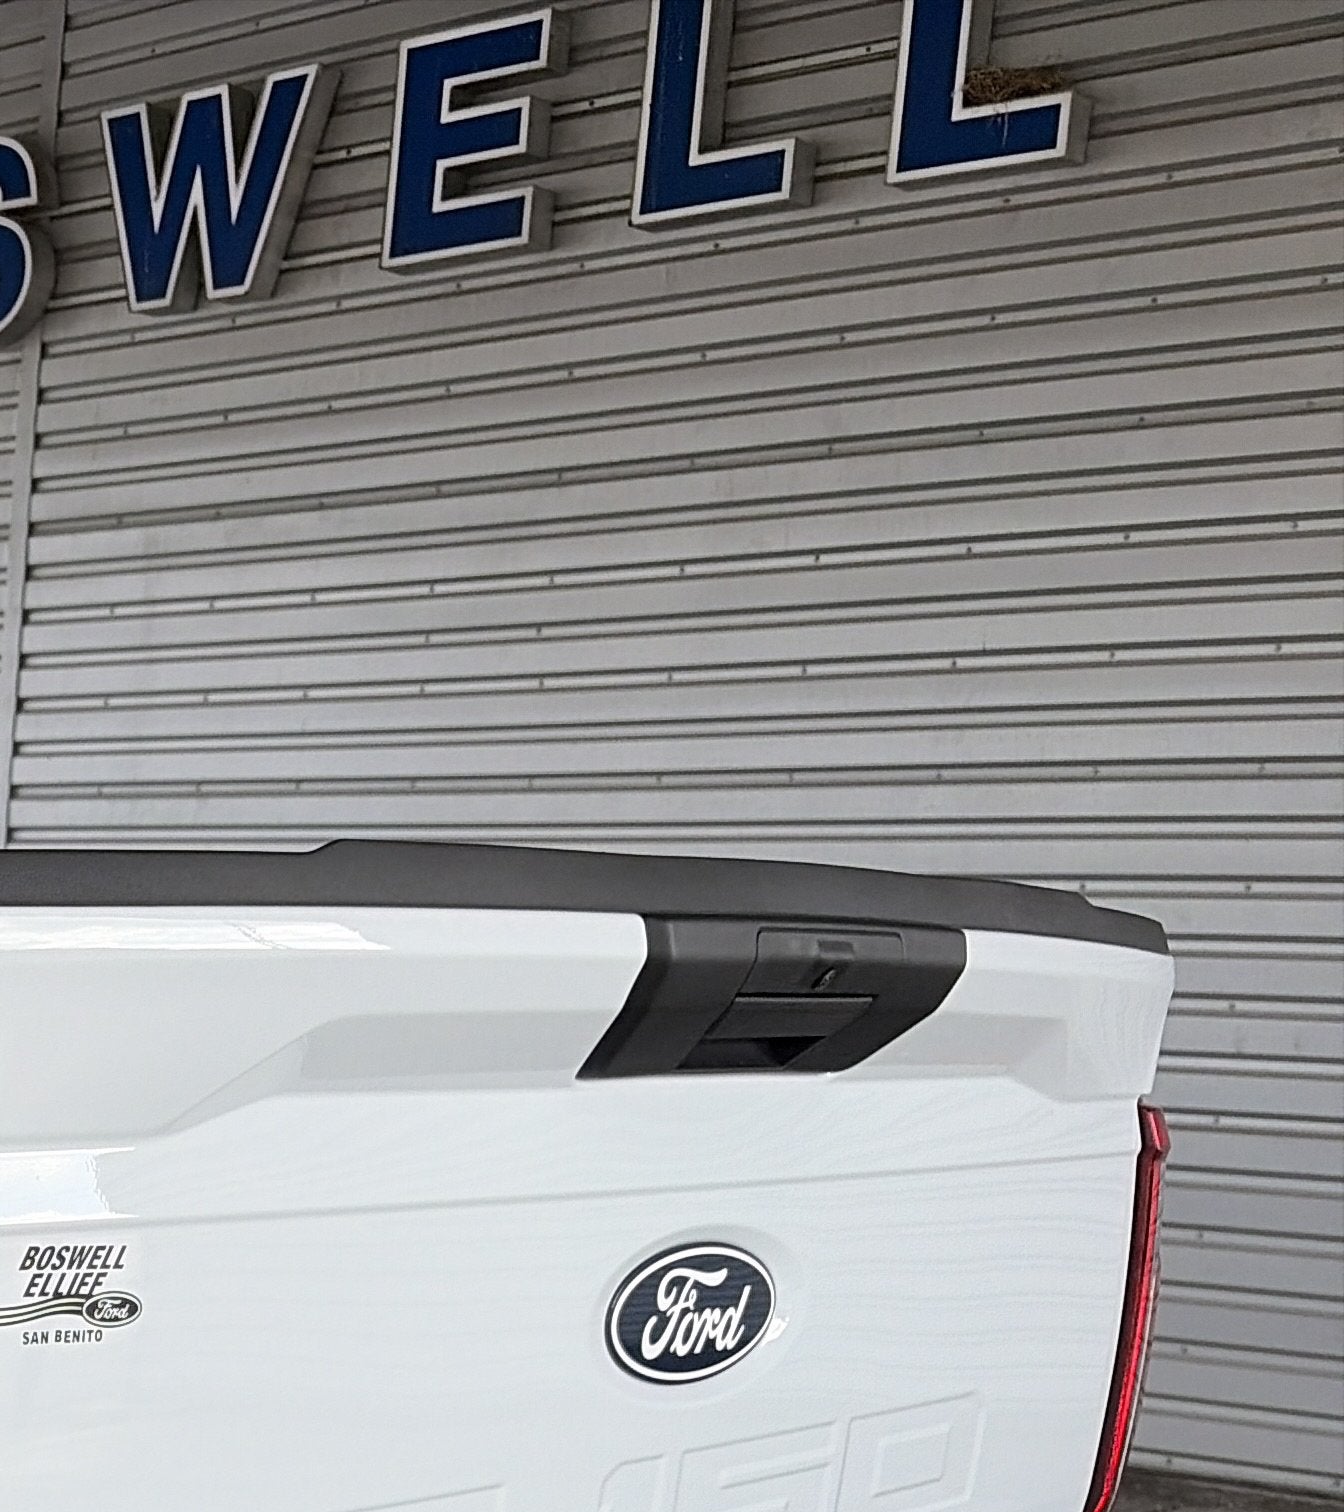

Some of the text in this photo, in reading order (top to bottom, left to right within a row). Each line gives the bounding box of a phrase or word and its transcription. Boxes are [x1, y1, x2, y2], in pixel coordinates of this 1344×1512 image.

[18, 1244, 128, 1272] BOSWELL
[22, 1271, 109, 1299] ELLIFF
[21, 1329, 104, 1346] SAN BENITO
